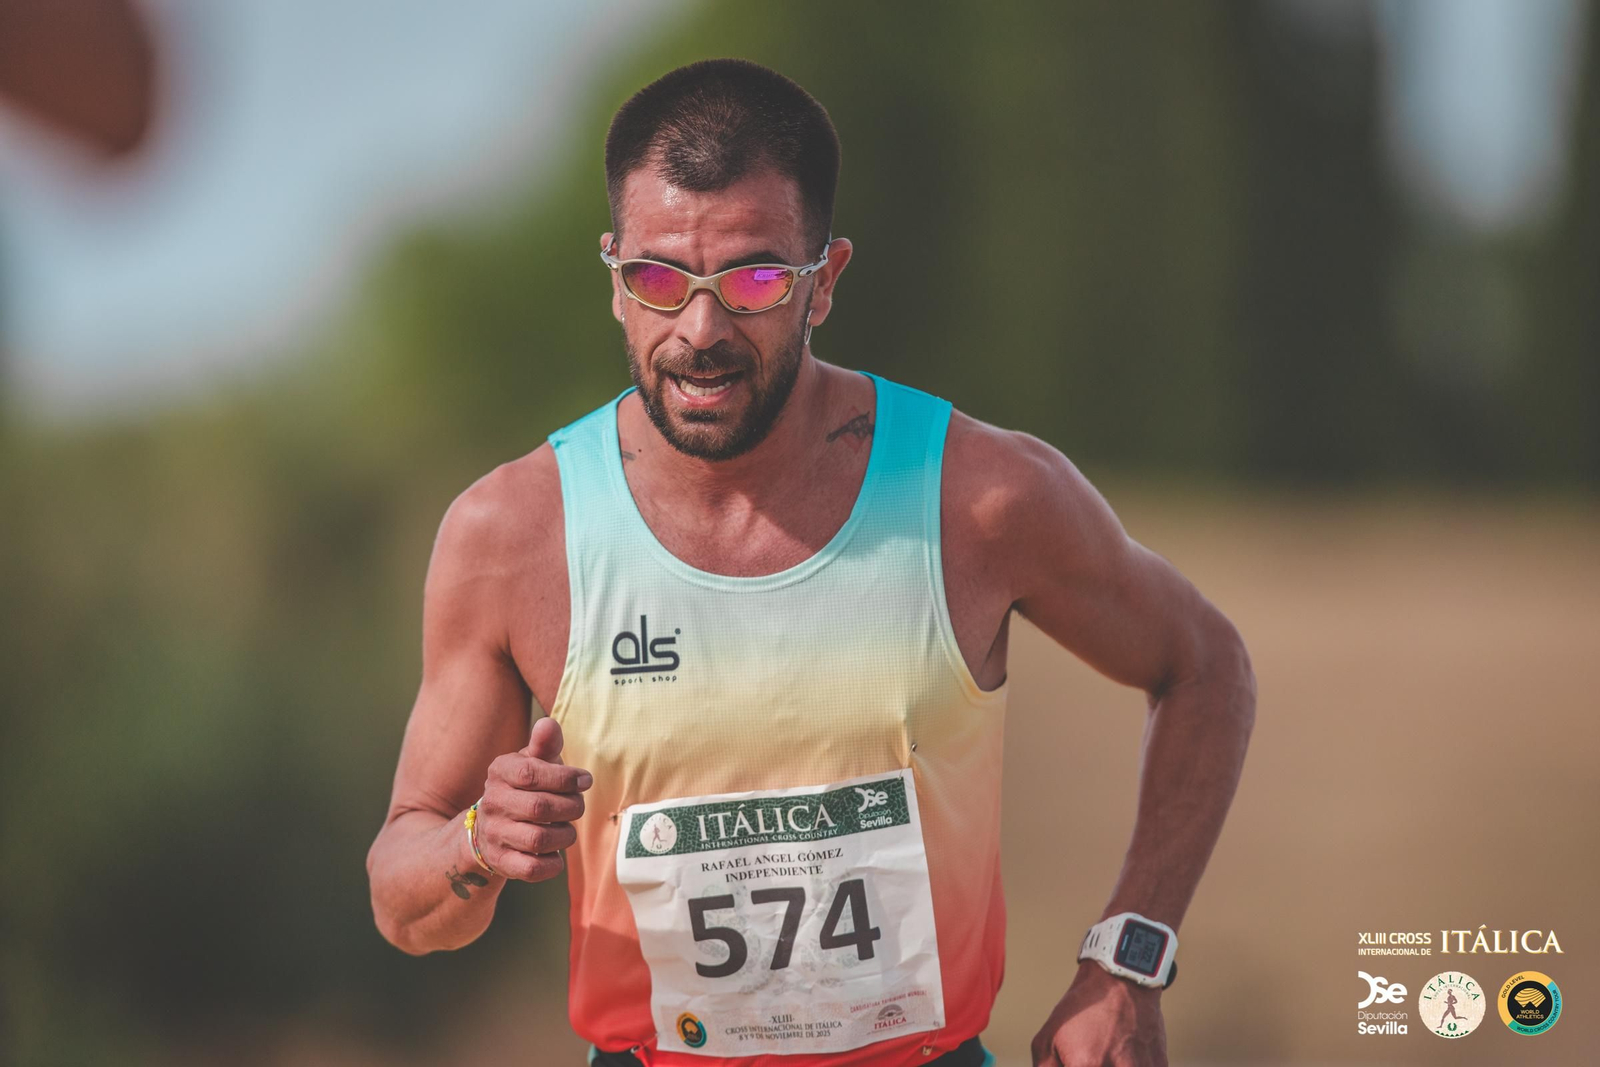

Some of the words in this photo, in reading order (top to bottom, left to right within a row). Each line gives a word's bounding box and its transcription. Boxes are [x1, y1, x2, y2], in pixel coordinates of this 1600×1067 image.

[610, 614, 681, 675] als
[614, 677, 643, 686] sport
[652, 675, 678, 683] shop
[696, 803, 838, 842] ITÁLICA
[860, 816, 893, 829] Sevilla
[701, 836, 769, 850] INTERNATIONAL
[799, 828, 838, 840] COUNTRY
[701, 856, 751, 872] RAFAEL
[754, 853, 796, 865] ANGEL
[797, 847, 844, 862] GÓMEZ
[725, 865, 824, 883] INDEPENDIENTE
[687, 878, 881, 979] 574
[725, 1026, 748, 1035] CROSS
[749, 1023, 803, 1033] INTERNACIONAL
[805, 1023, 813, 1031] DE
[765, 1031, 803, 1040] NOVIEMBRE
[816, 1030, 831, 1038] 2025
